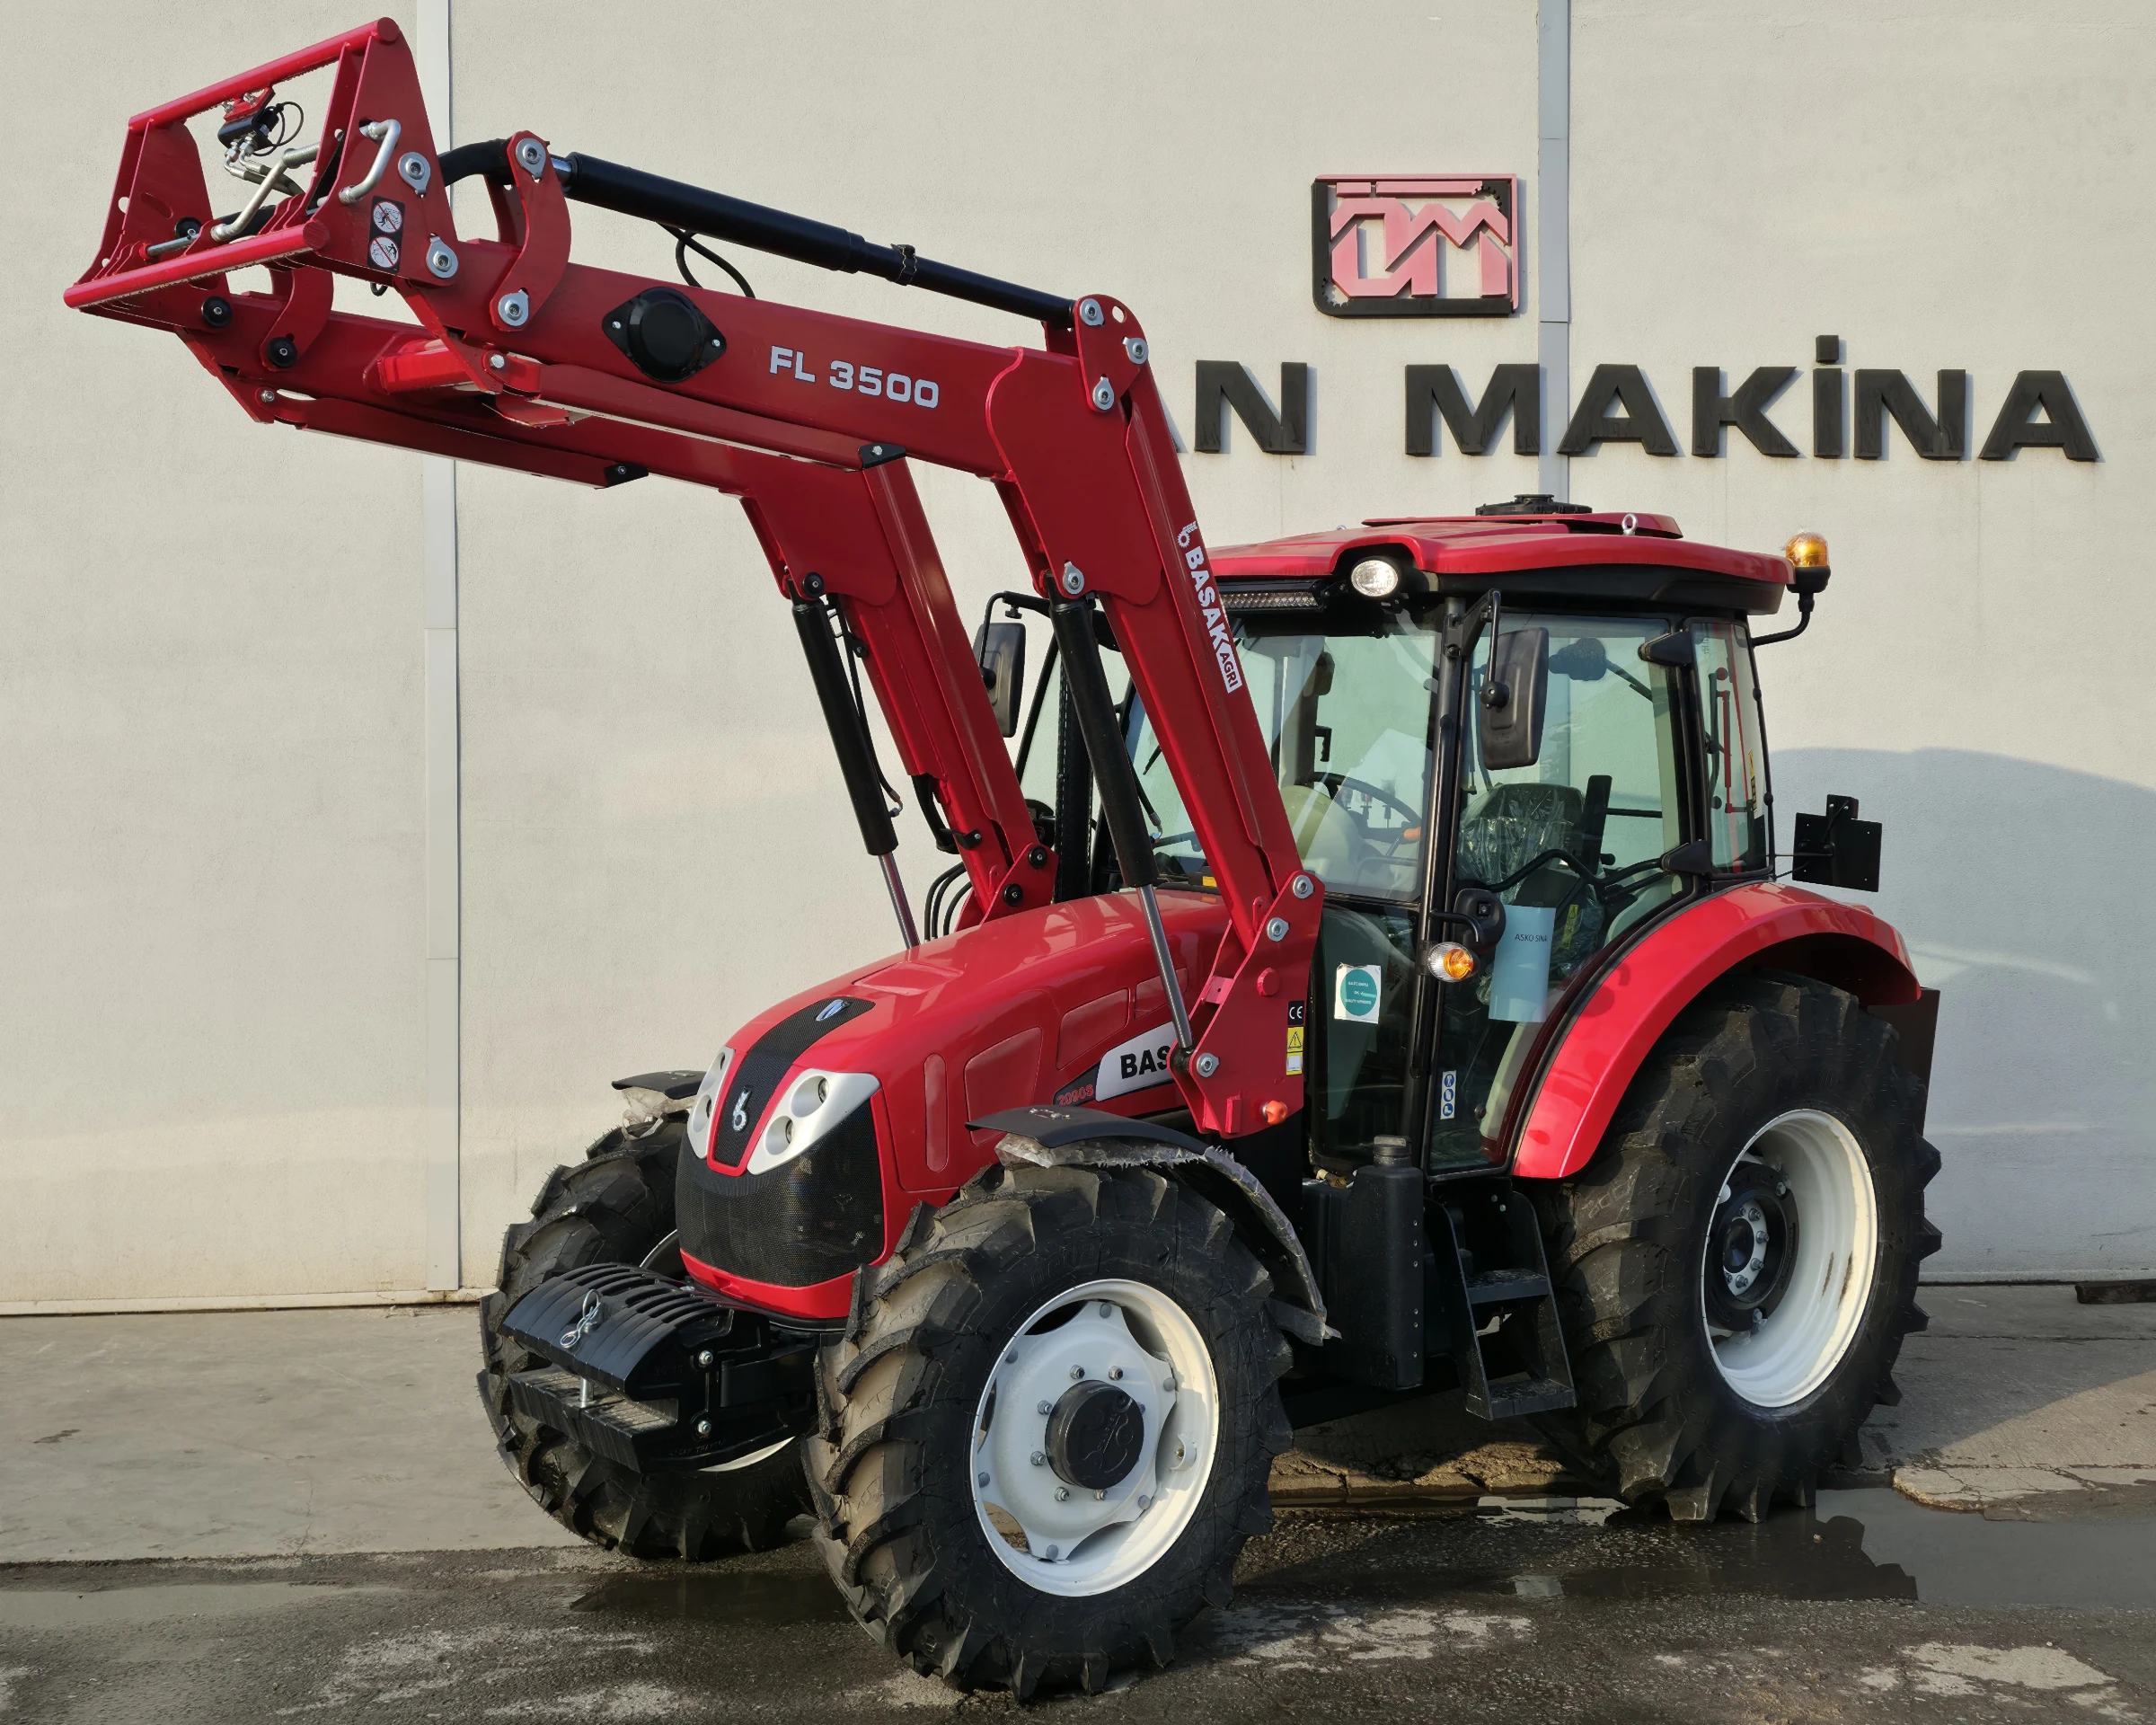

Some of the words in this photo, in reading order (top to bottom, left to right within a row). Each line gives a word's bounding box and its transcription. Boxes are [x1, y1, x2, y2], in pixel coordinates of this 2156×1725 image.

[769, 344, 817, 383] FL
[828, 359, 941, 409] 3500
[1185, 545, 1230, 650] BASAK
[1219, 651, 1239, 689] AGRI
[1514, 933, 1534, 942] ASKO
[1288, 1005, 1303, 1020] CE
[1056, 1084, 1095, 1107] 2090S
